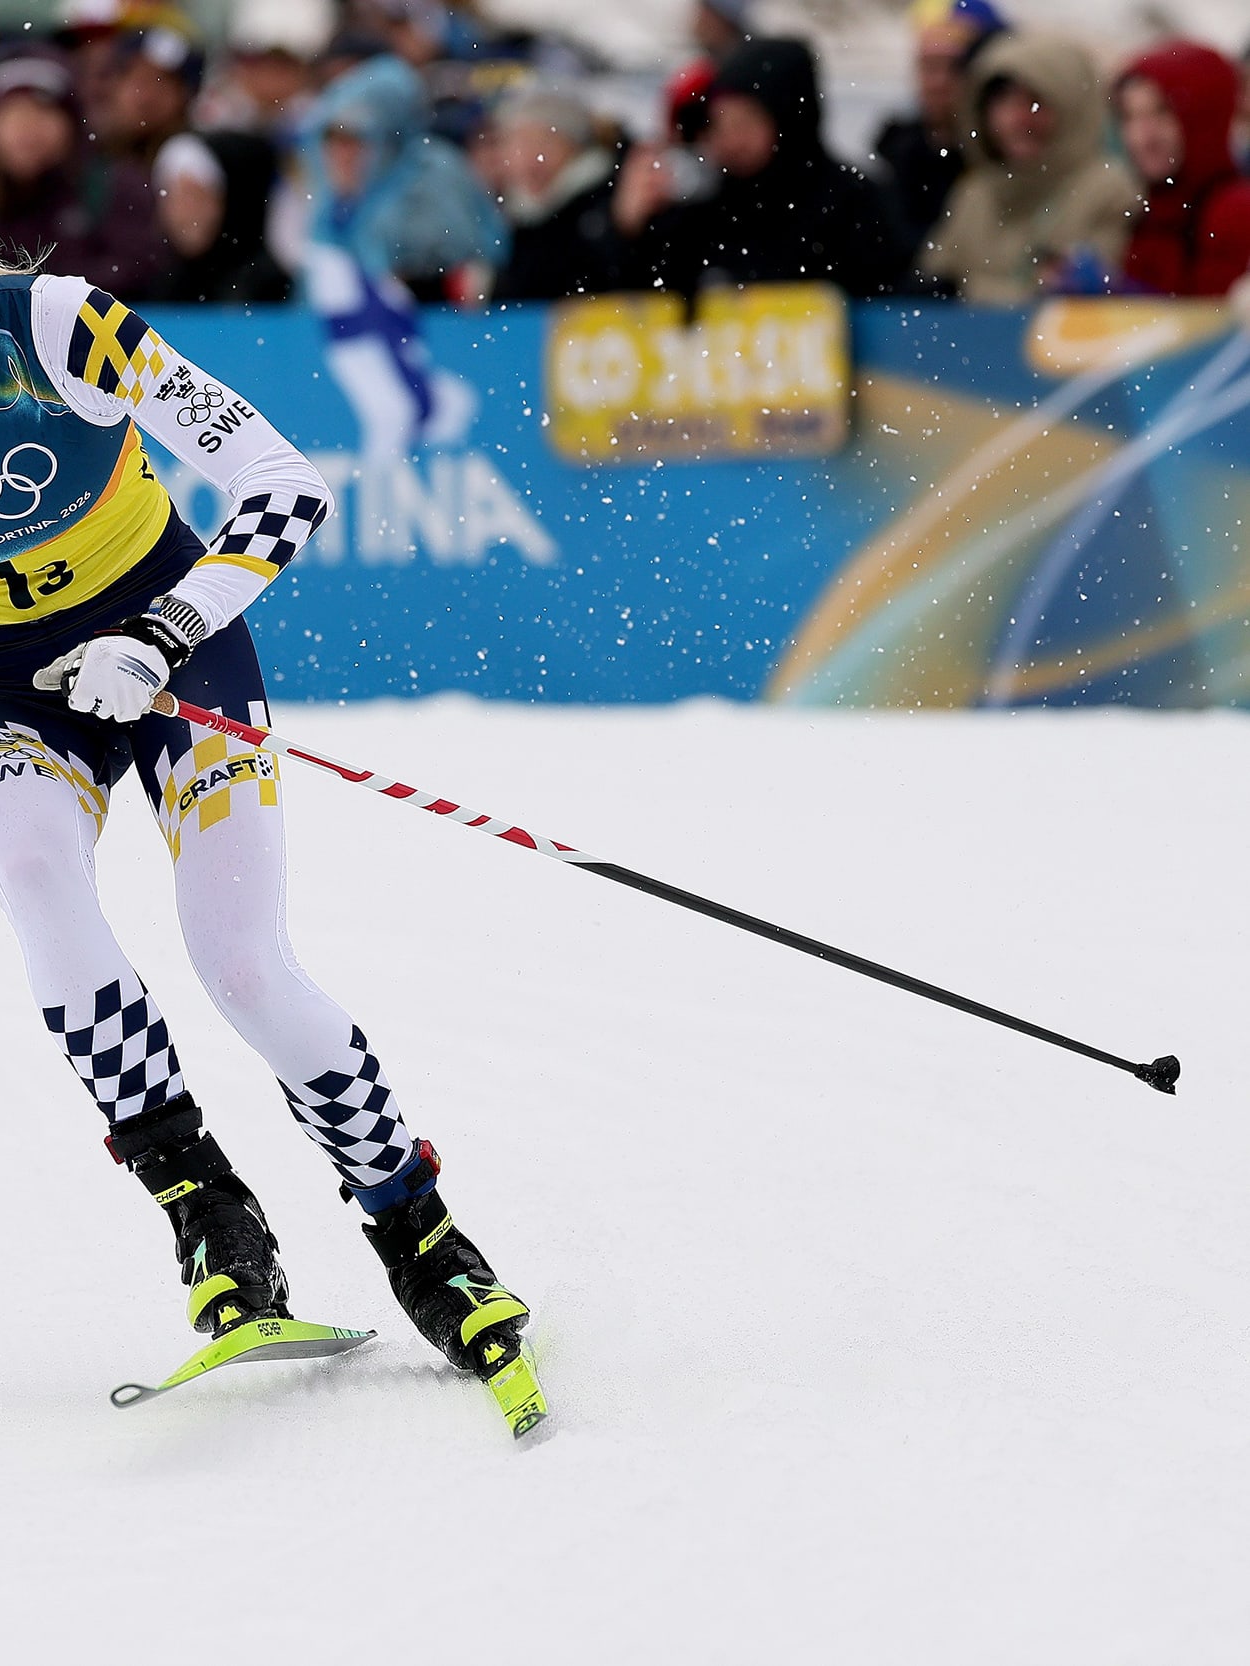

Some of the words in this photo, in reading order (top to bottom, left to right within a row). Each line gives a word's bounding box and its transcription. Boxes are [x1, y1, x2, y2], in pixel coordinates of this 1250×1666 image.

[197, 400, 256, 454] SWE
[59, 490, 92, 519] 2026
[179, 758, 257, 812] CRAFT
